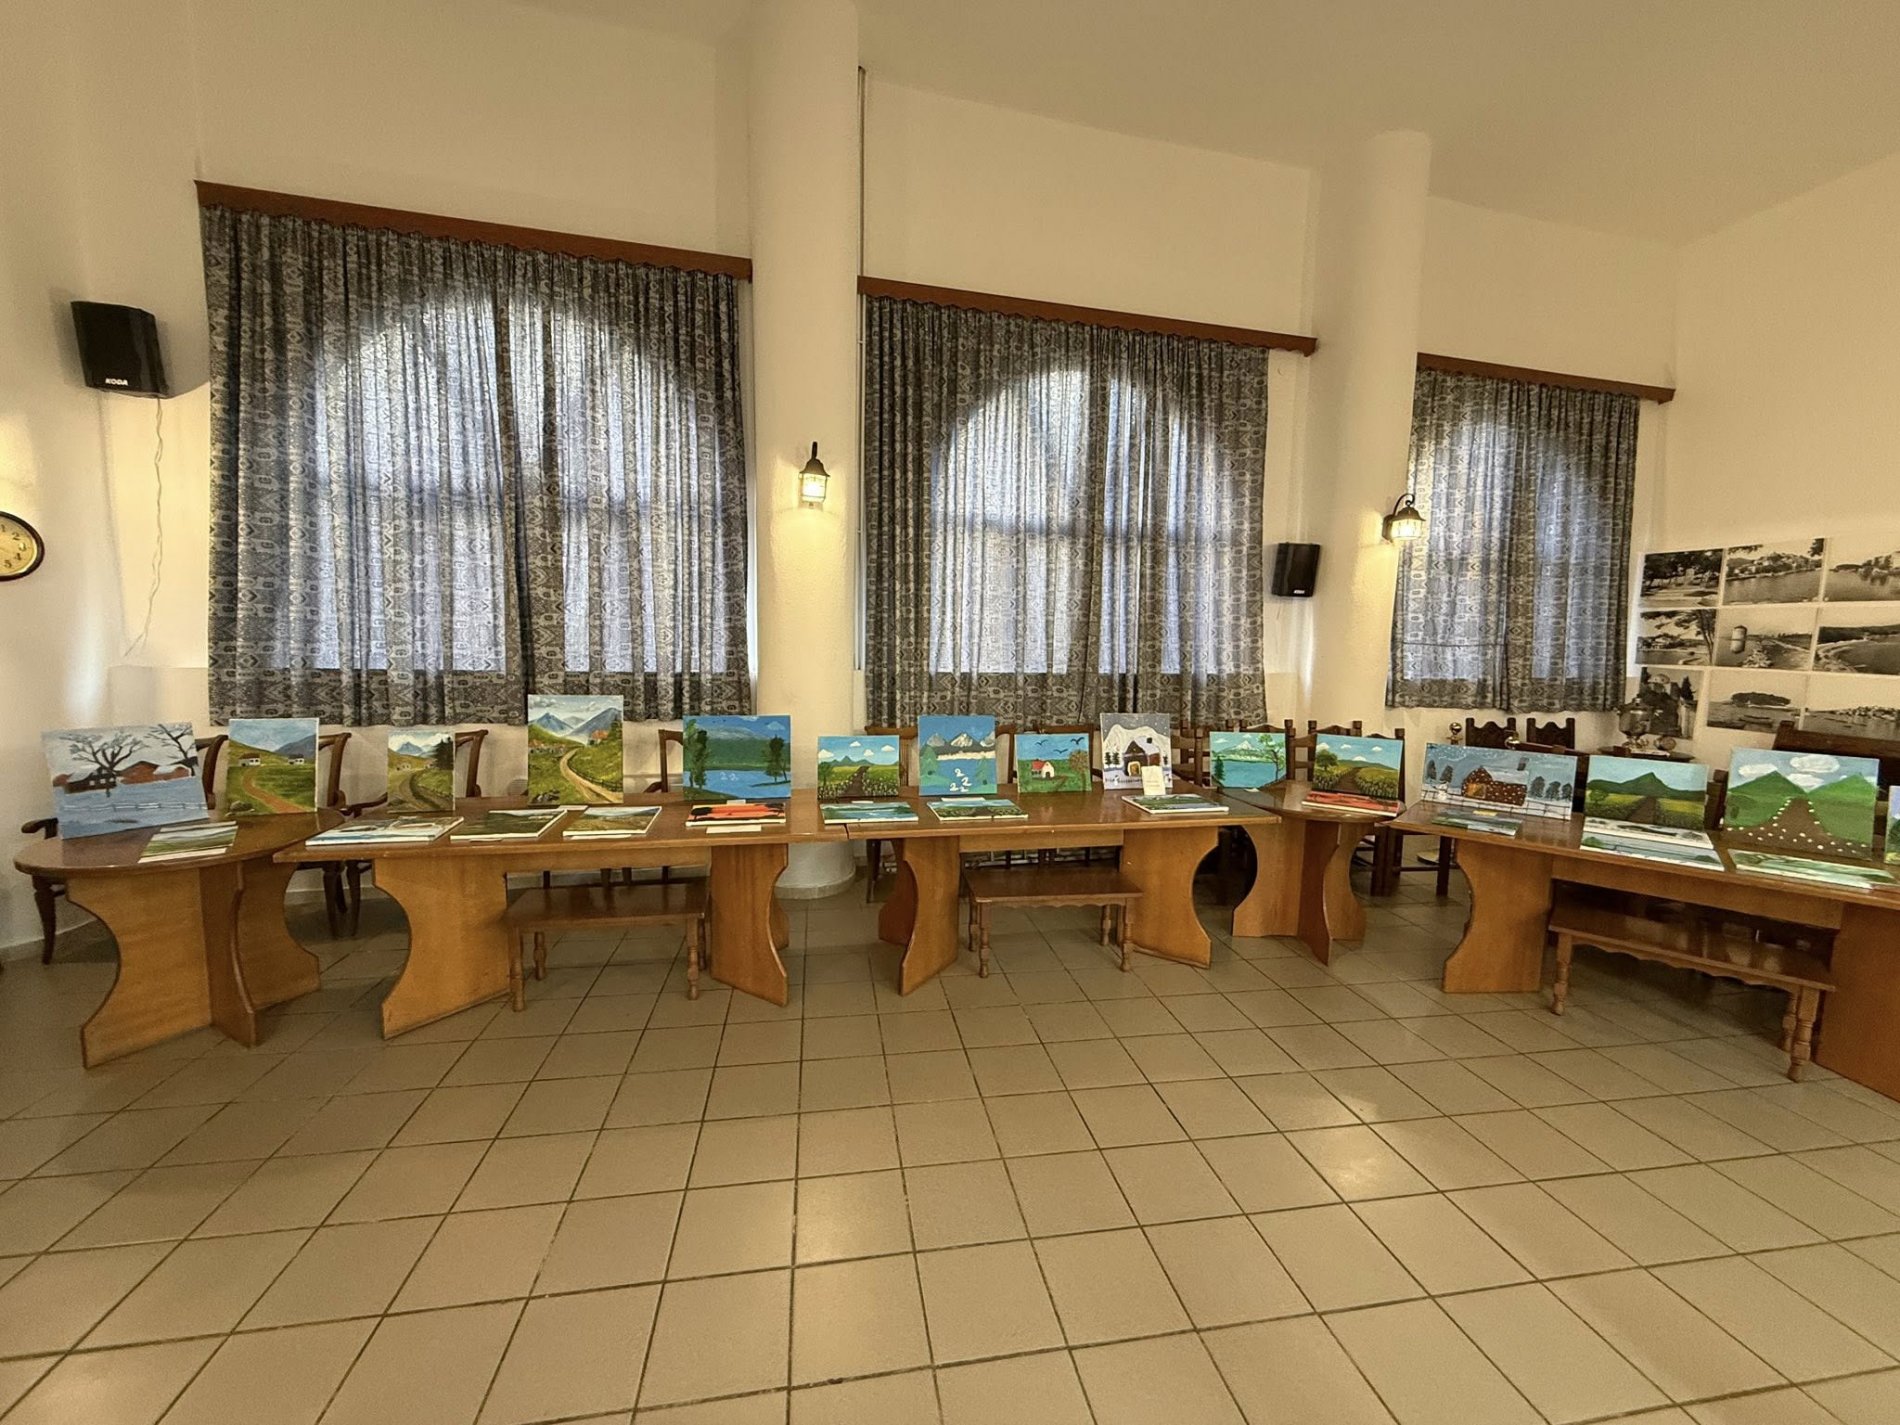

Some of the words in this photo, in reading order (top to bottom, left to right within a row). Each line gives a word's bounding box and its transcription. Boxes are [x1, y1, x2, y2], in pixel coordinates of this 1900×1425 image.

[105, 378, 128, 386] KODA
[11, 532, 20, 540] 2
[14, 552, 21, 561] 4
[4, 560, 12, 568] 5
